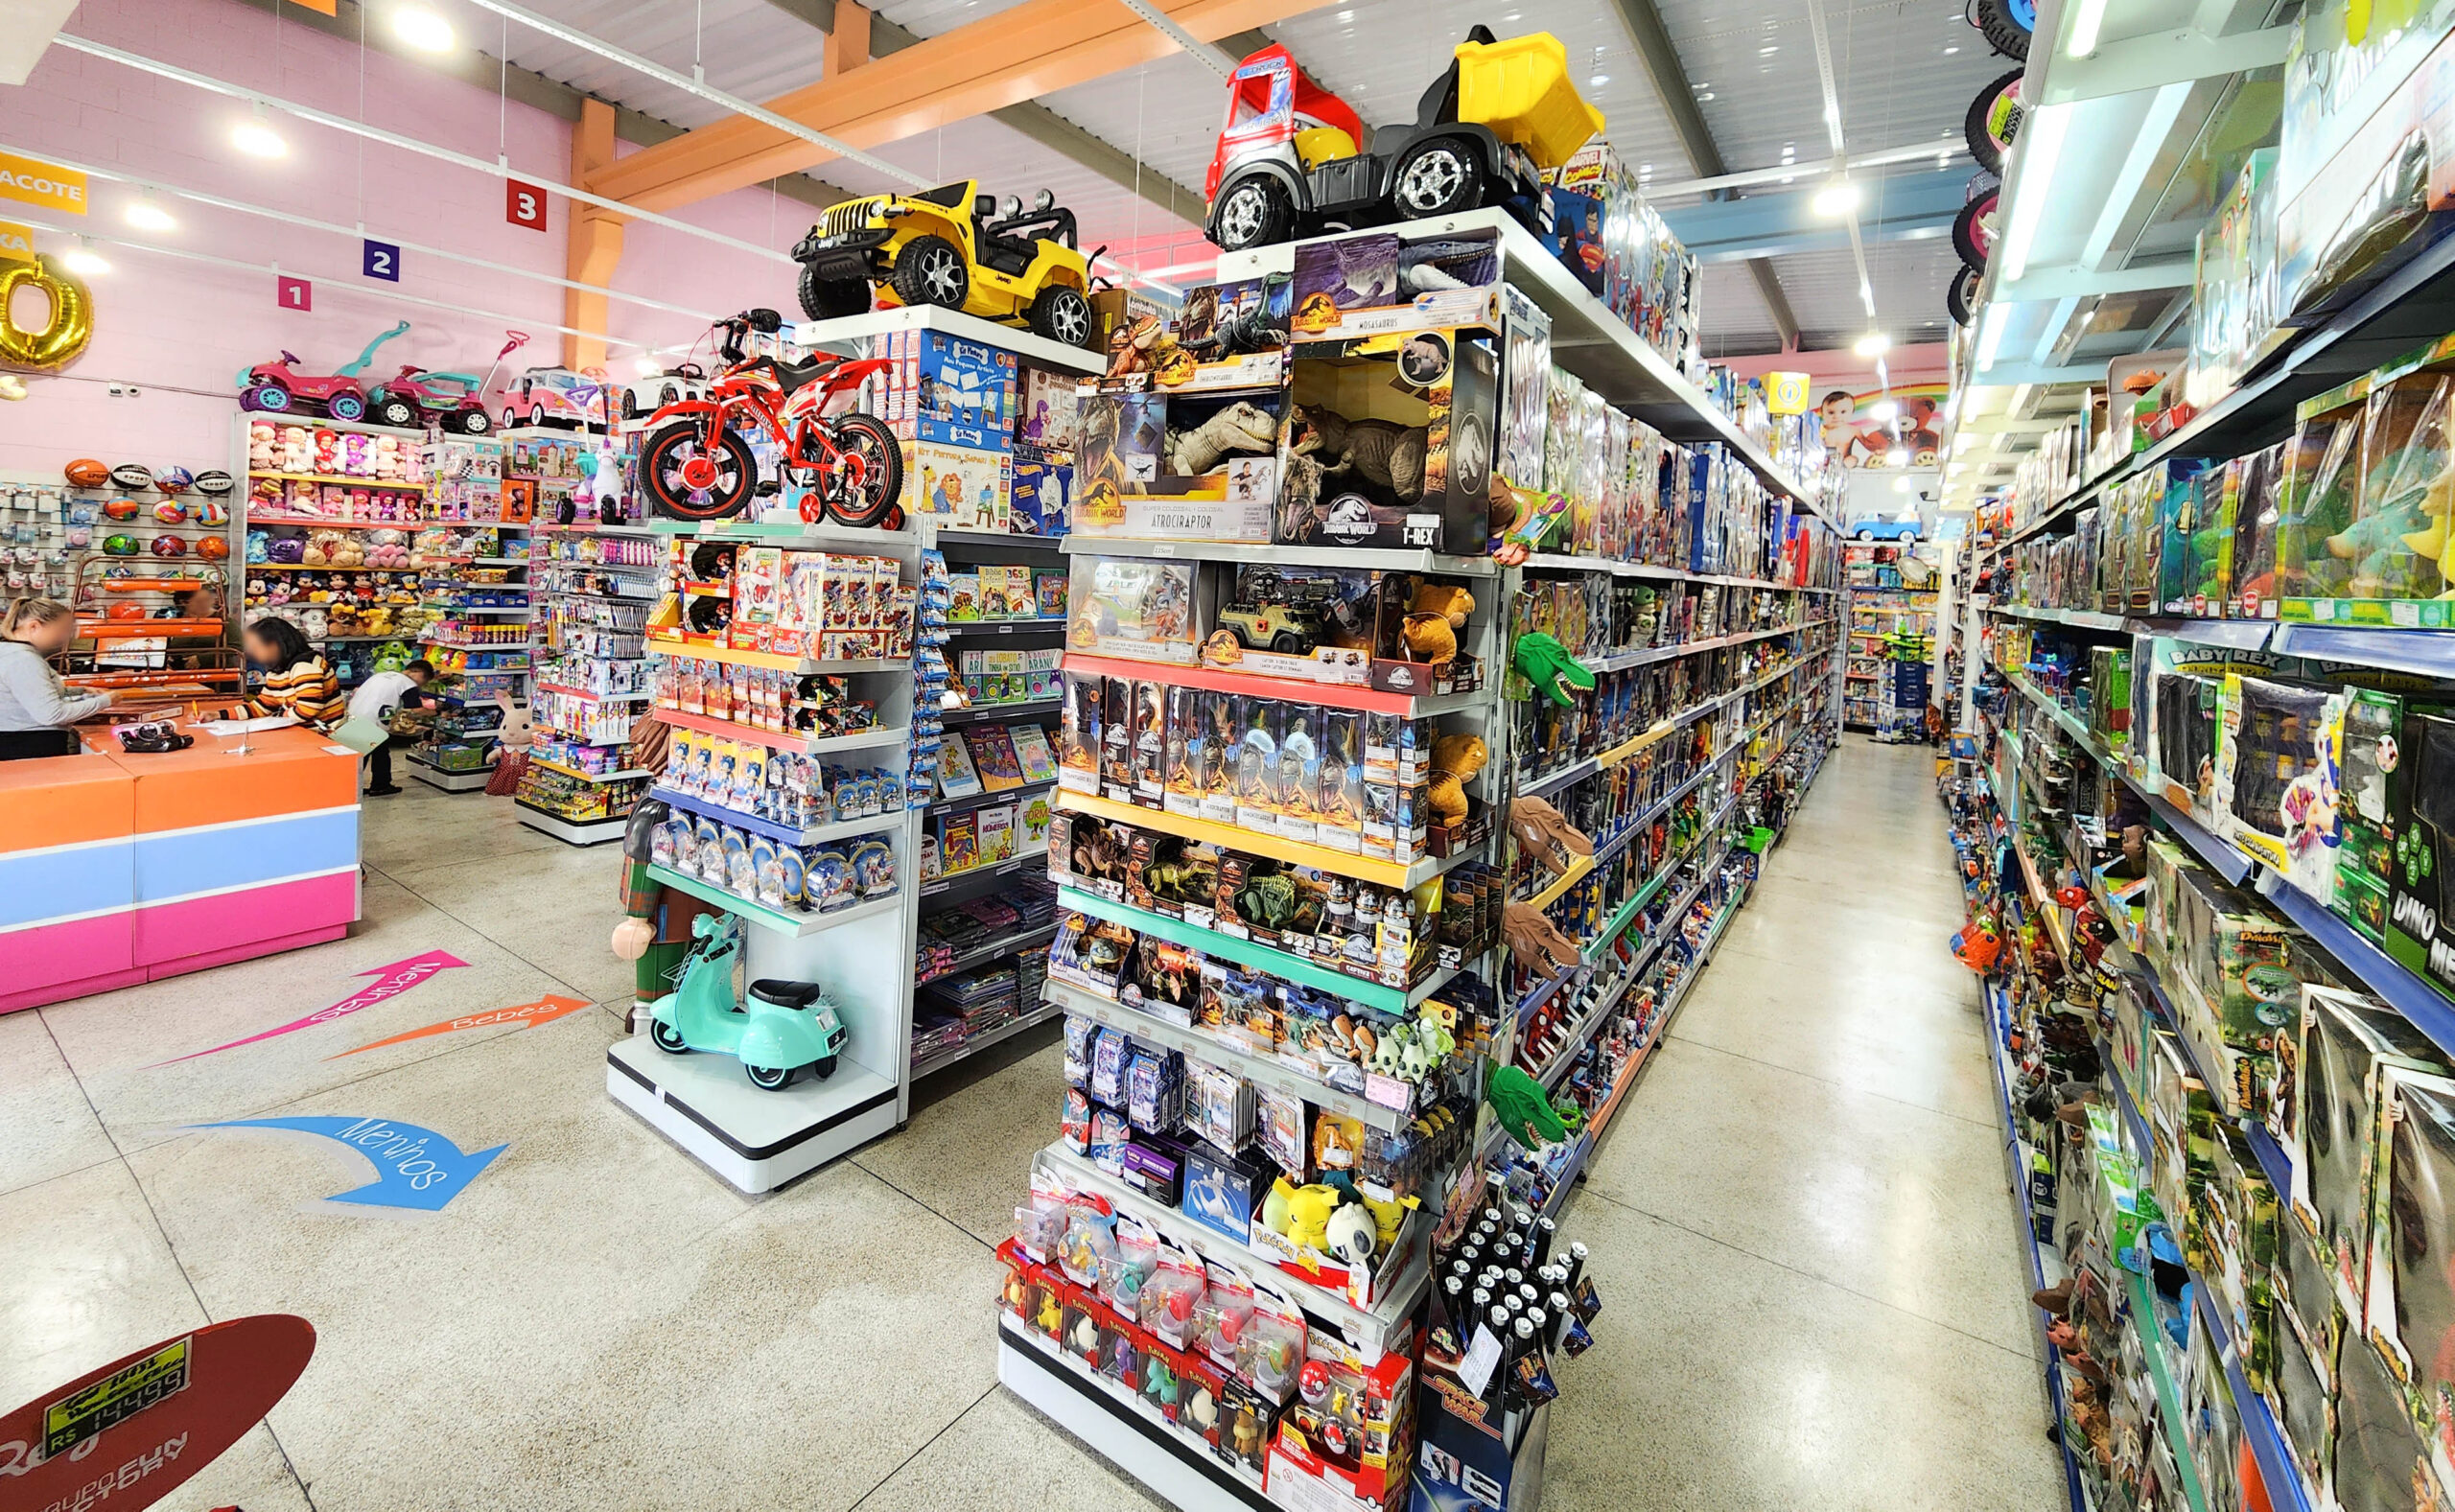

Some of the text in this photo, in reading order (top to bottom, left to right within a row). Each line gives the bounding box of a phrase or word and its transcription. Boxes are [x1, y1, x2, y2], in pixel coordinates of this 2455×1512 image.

[1567, 150, 1601, 169] MARVEL
[0, 170, 82, 201] ACOTE
[1564, 164, 1602, 185] COMICS
[517, 193, 537, 221] 3
[372, 251, 391, 274] 2
[289, 287, 301, 306] 1
[1318, 314, 1342, 325] WORLD
[1359, 318, 1398, 330] MOSASAURUS
[1151, 514, 1212, 529] ATROCIRAPTOR
[1349, 523, 1376, 535] WORLD
[1402, 527, 1434, 546] T-REX
[1007, 569, 1023, 579] 365
[2170, 649, 2282, 667] BABY REX
[2393, 889, 2436, 941] DINO
[310, 961, 441, 1021] Meninas
[451, 1002, 558, 1030] Bebês
[335, 1118, 447, 1191] Meninos
[1252, 1227, 1295, 1260] Pokémon
[1308, 1332, 1343, 1359] Pokémon
[1434, 1376, 1489, 1415] SPACE
[1443, 1393, 1483, 1424] WAR
[42, 1472, 115, 1512] RUPO
